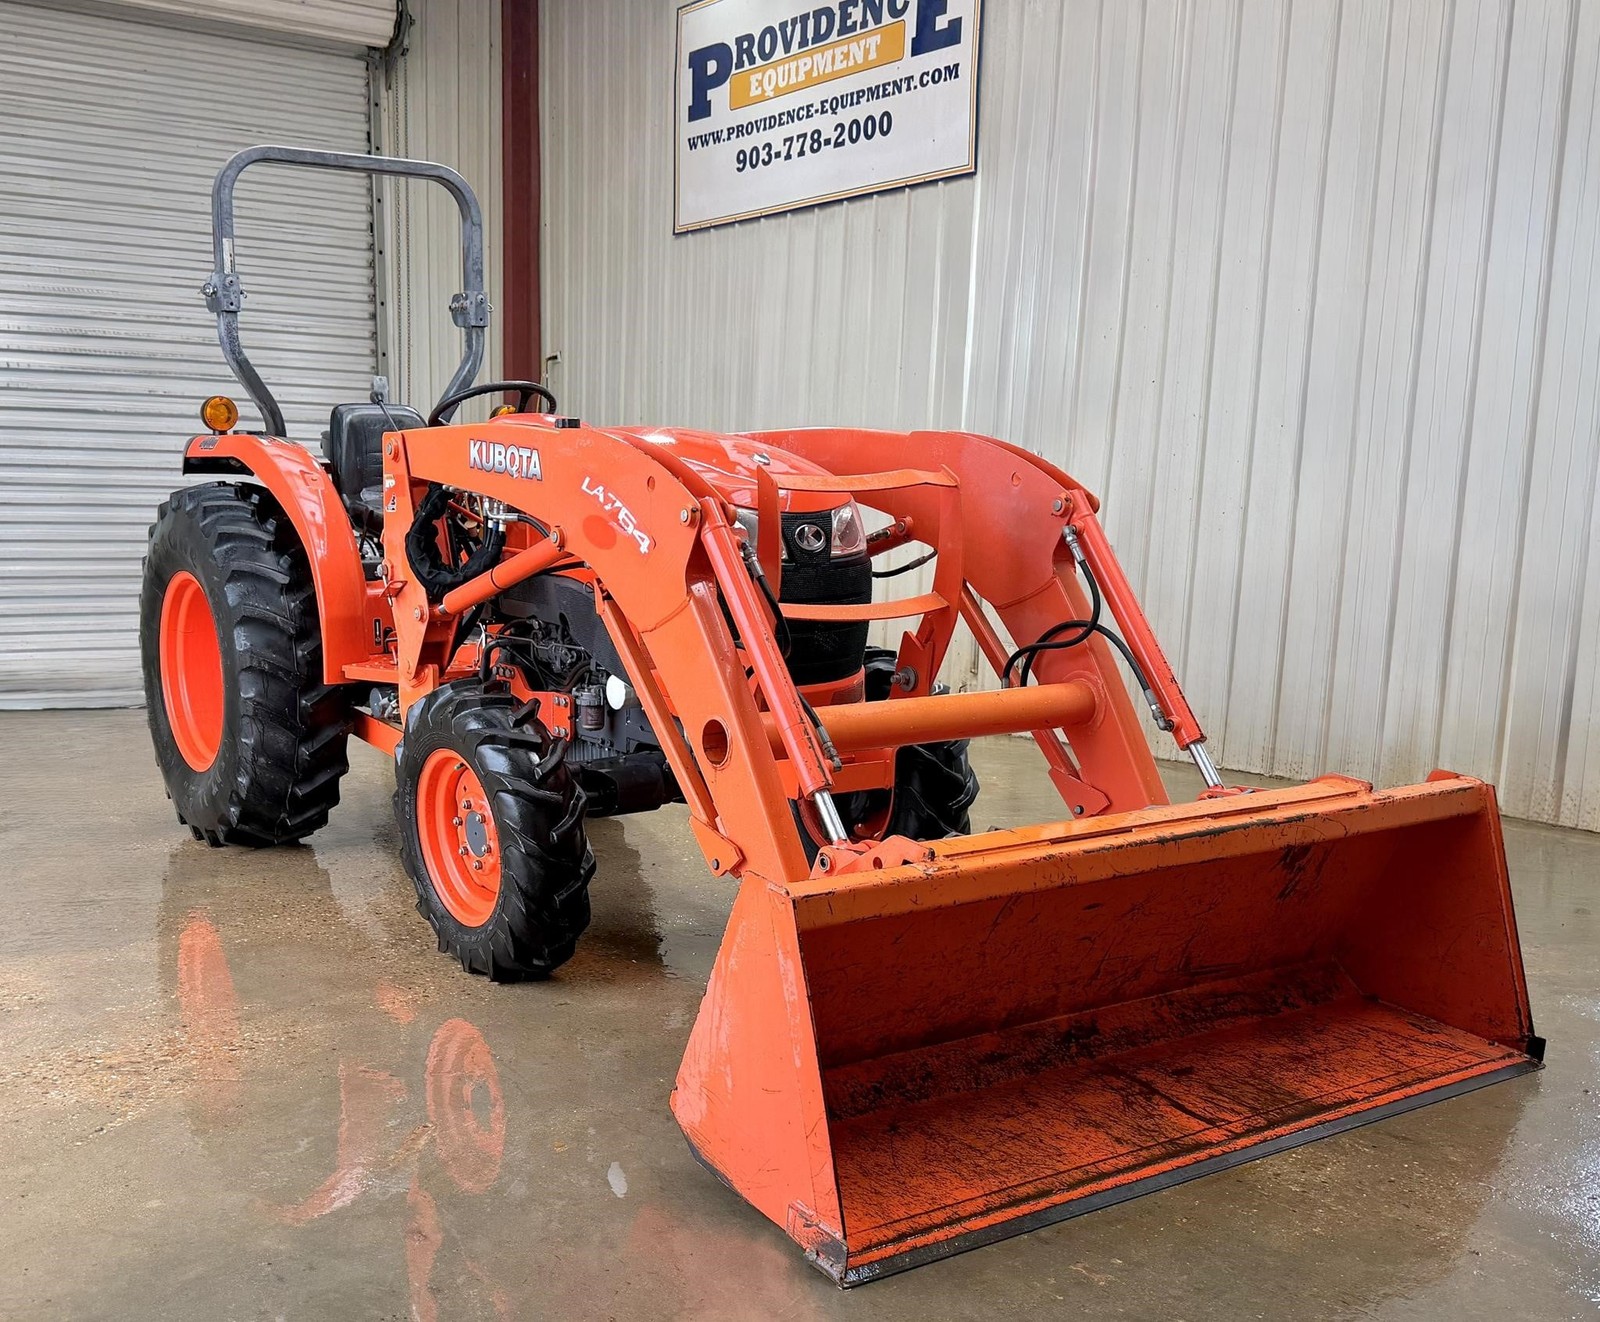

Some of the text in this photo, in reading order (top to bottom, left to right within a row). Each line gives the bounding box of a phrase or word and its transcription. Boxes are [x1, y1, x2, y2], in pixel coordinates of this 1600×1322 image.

[750, 34, 881, 97] EQUIPMENT
[687, 63, 960, 151] WWW.PROVIDENCE-EQUIPMENT.COM
[735, 111, 893, 172] 903-778-2000
[469, 438, 543, 481] KUBOTA
